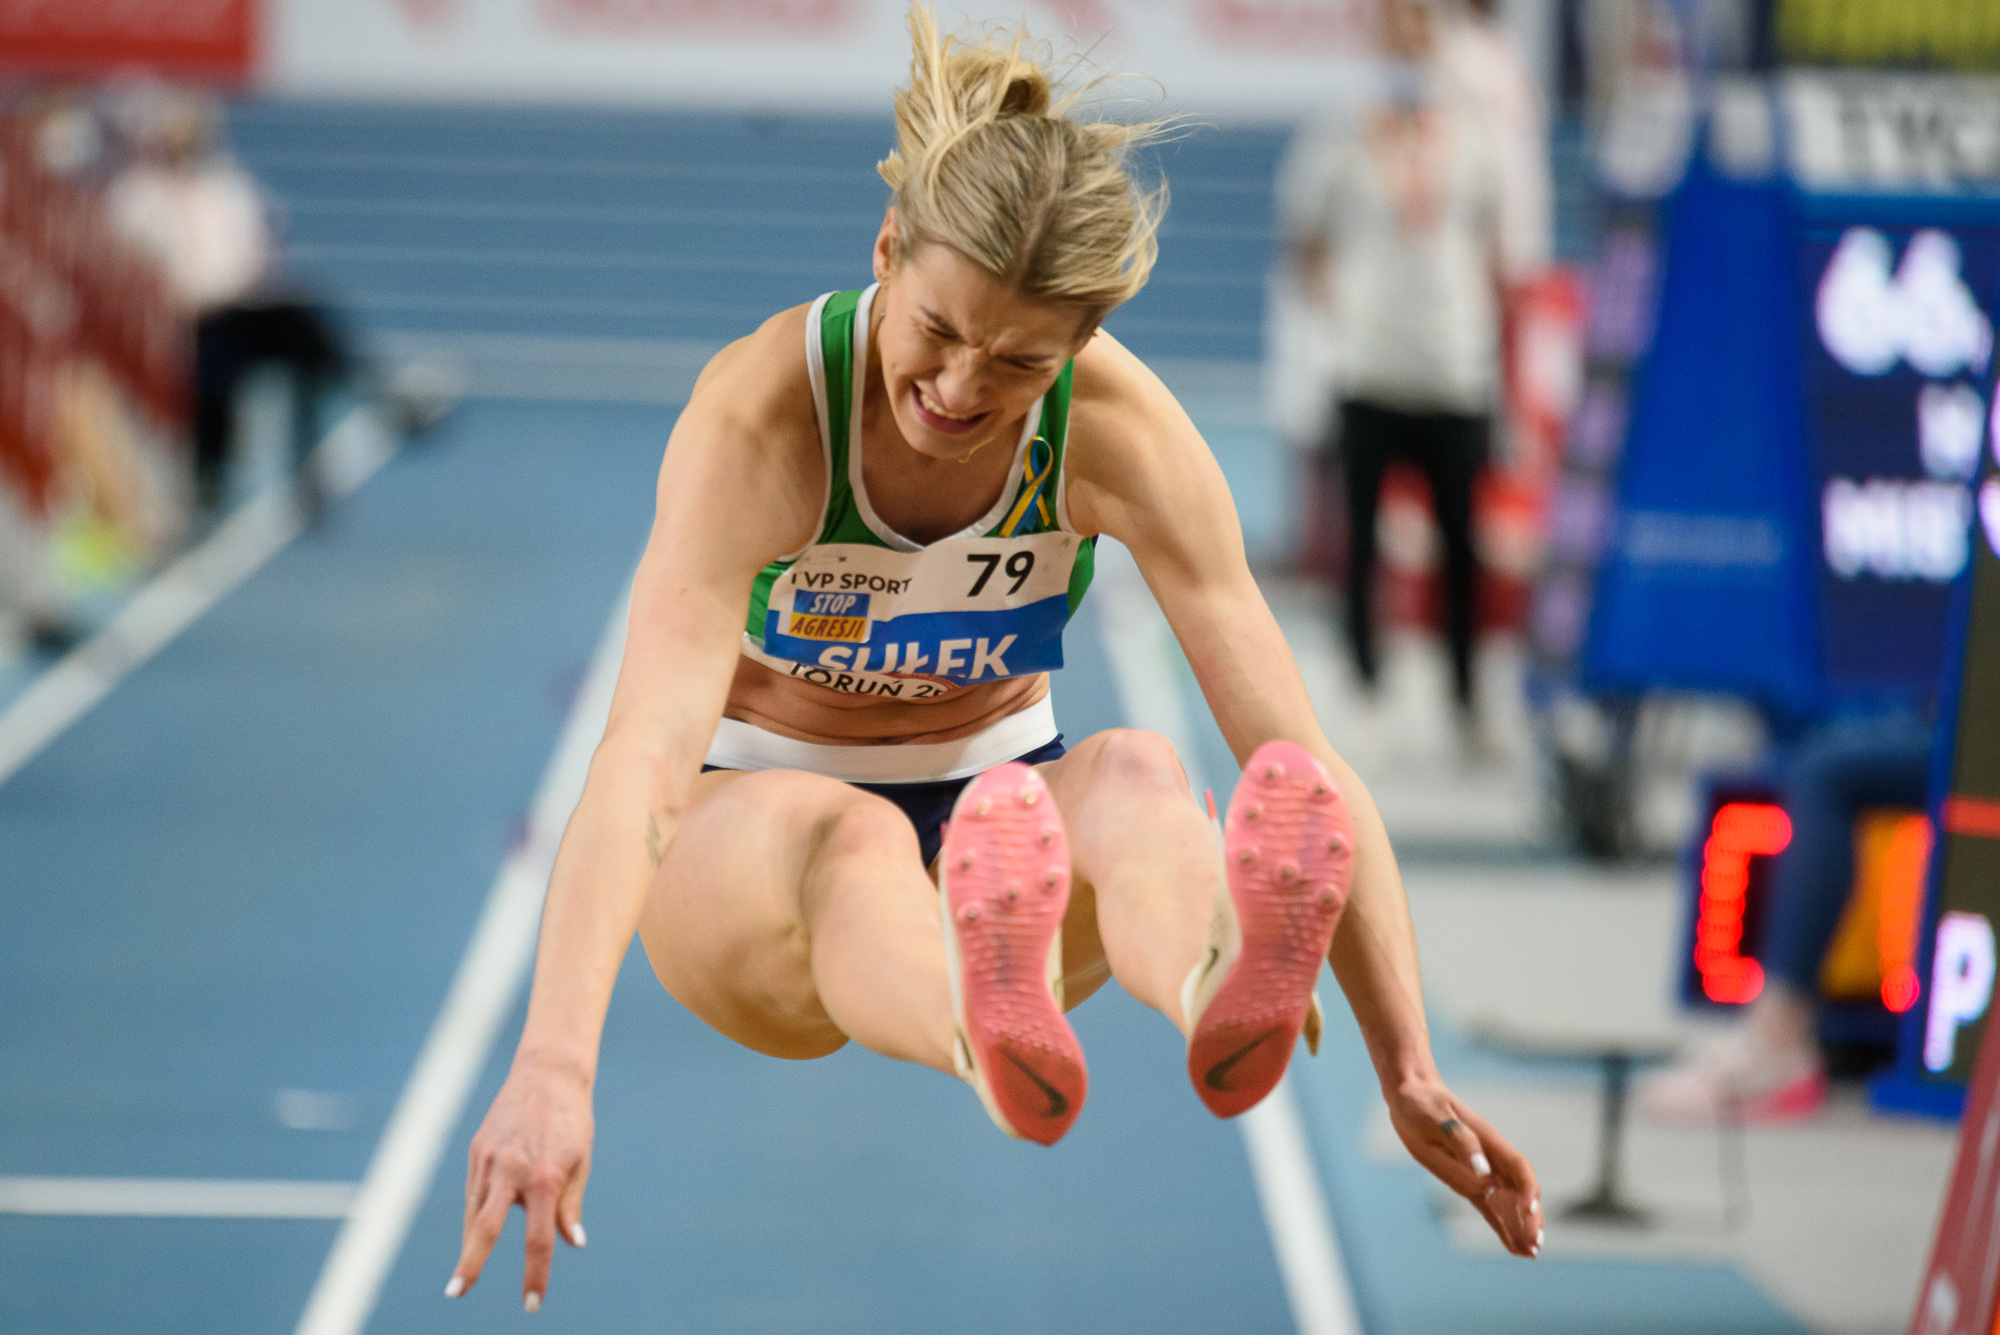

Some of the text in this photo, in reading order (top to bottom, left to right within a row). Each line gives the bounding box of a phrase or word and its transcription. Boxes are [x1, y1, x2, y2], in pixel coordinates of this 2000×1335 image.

[839, 573, 912, 595] SPORT
[966, 551, 1035, 598] 79
[809, 594, 857, 614] STOP
[791, 617, 865, 638] AGRESJI
[818, 634, 1018, 680] SUŁEK
